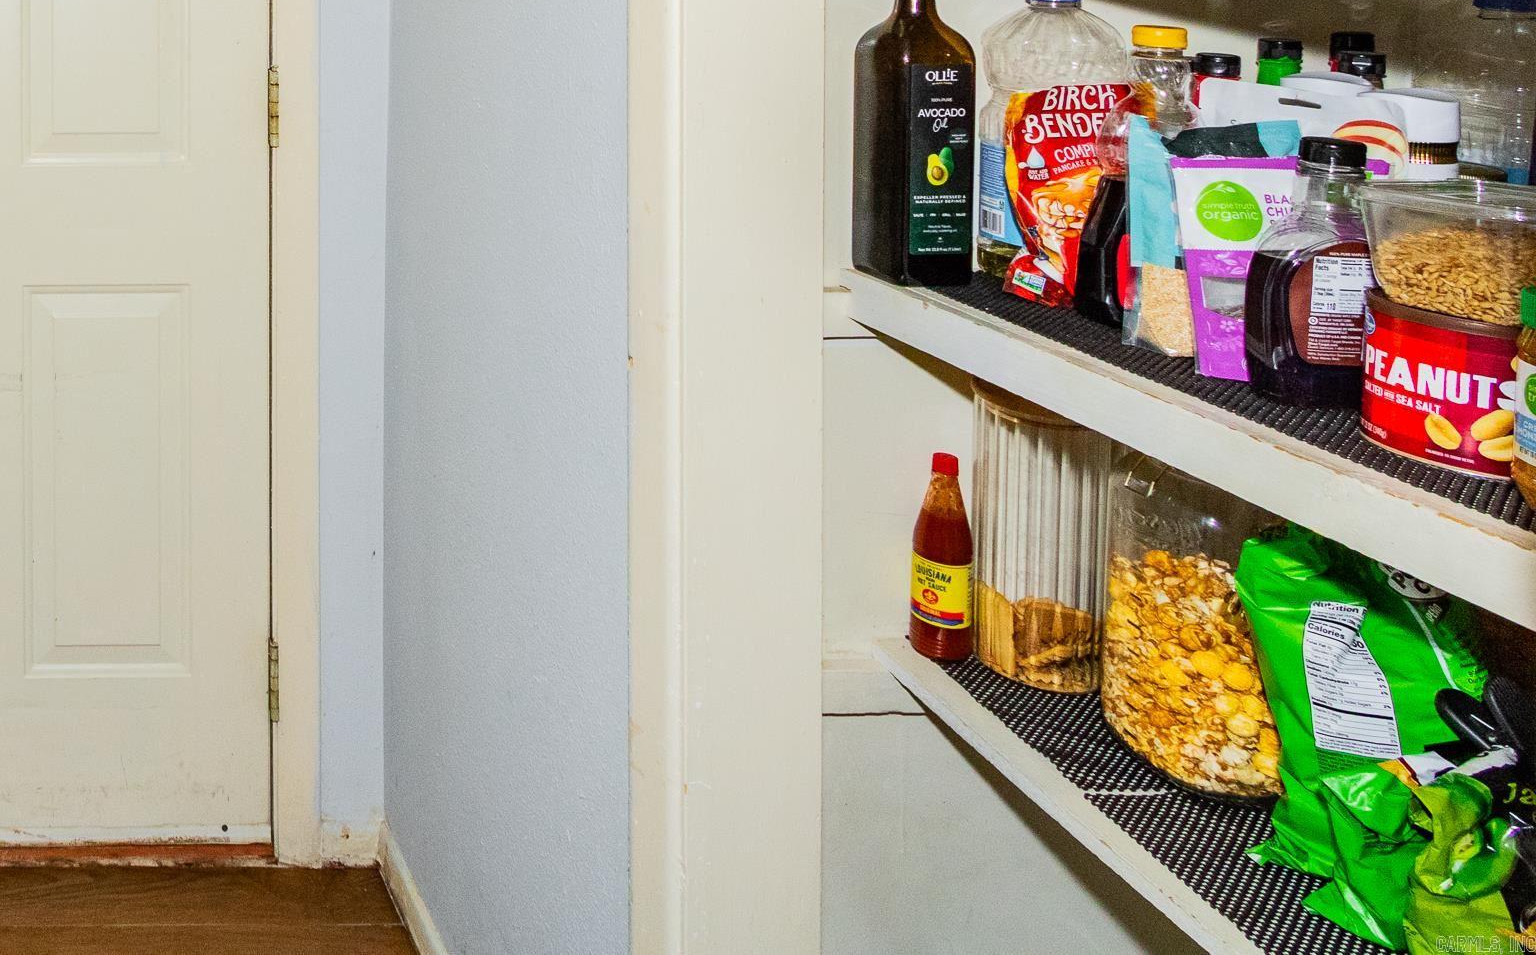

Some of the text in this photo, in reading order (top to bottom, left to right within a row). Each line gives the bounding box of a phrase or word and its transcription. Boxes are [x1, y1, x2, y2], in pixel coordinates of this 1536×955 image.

[1042, 84, 1117, 111] BIRCH
[917, 108, 966, 118] AVOCADO
[1052, 161, 1085, 175] PANCAKE
[1202, 209, 1259, 222] organic
[1396, 393, 1414, 408] SEA
[1415, 399, 1442, 415] SALT
[1307, 622, 1345, 640] Calories
